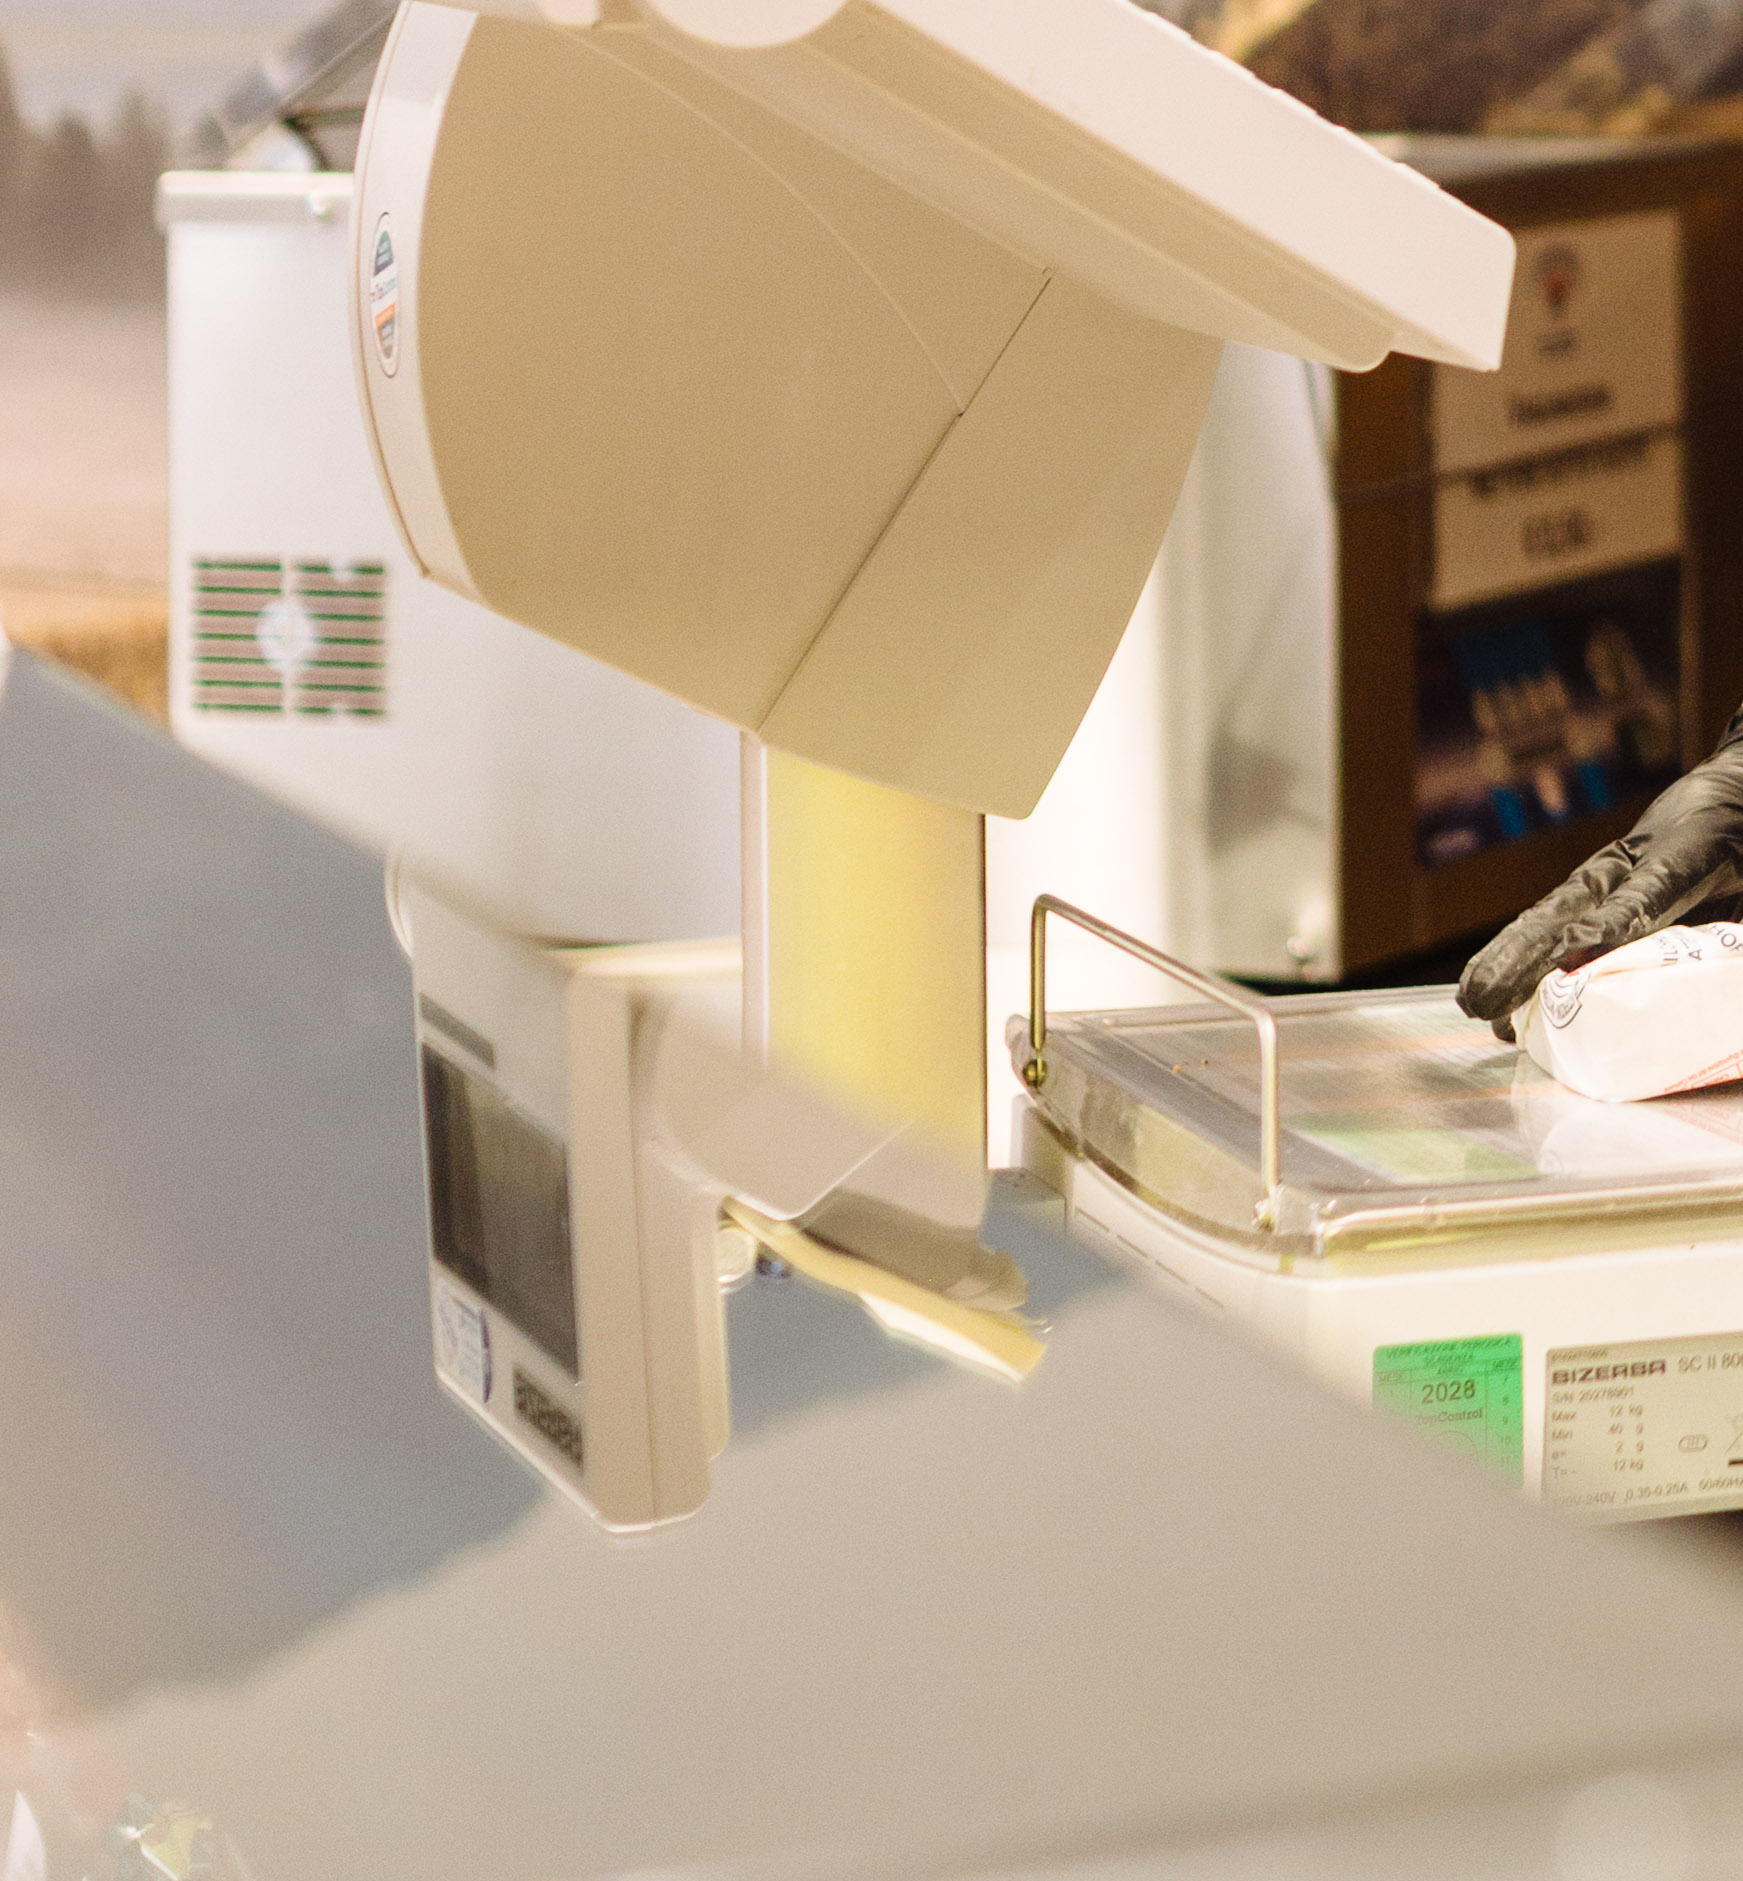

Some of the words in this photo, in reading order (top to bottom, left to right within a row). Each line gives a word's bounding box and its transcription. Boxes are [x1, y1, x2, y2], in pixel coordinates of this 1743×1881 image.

[1552, 1360, 1667, 1385] BIZERBA
[1678, 1356, 1702, 1373] SC
[1421, 1379, 1477, 1405] 2028
